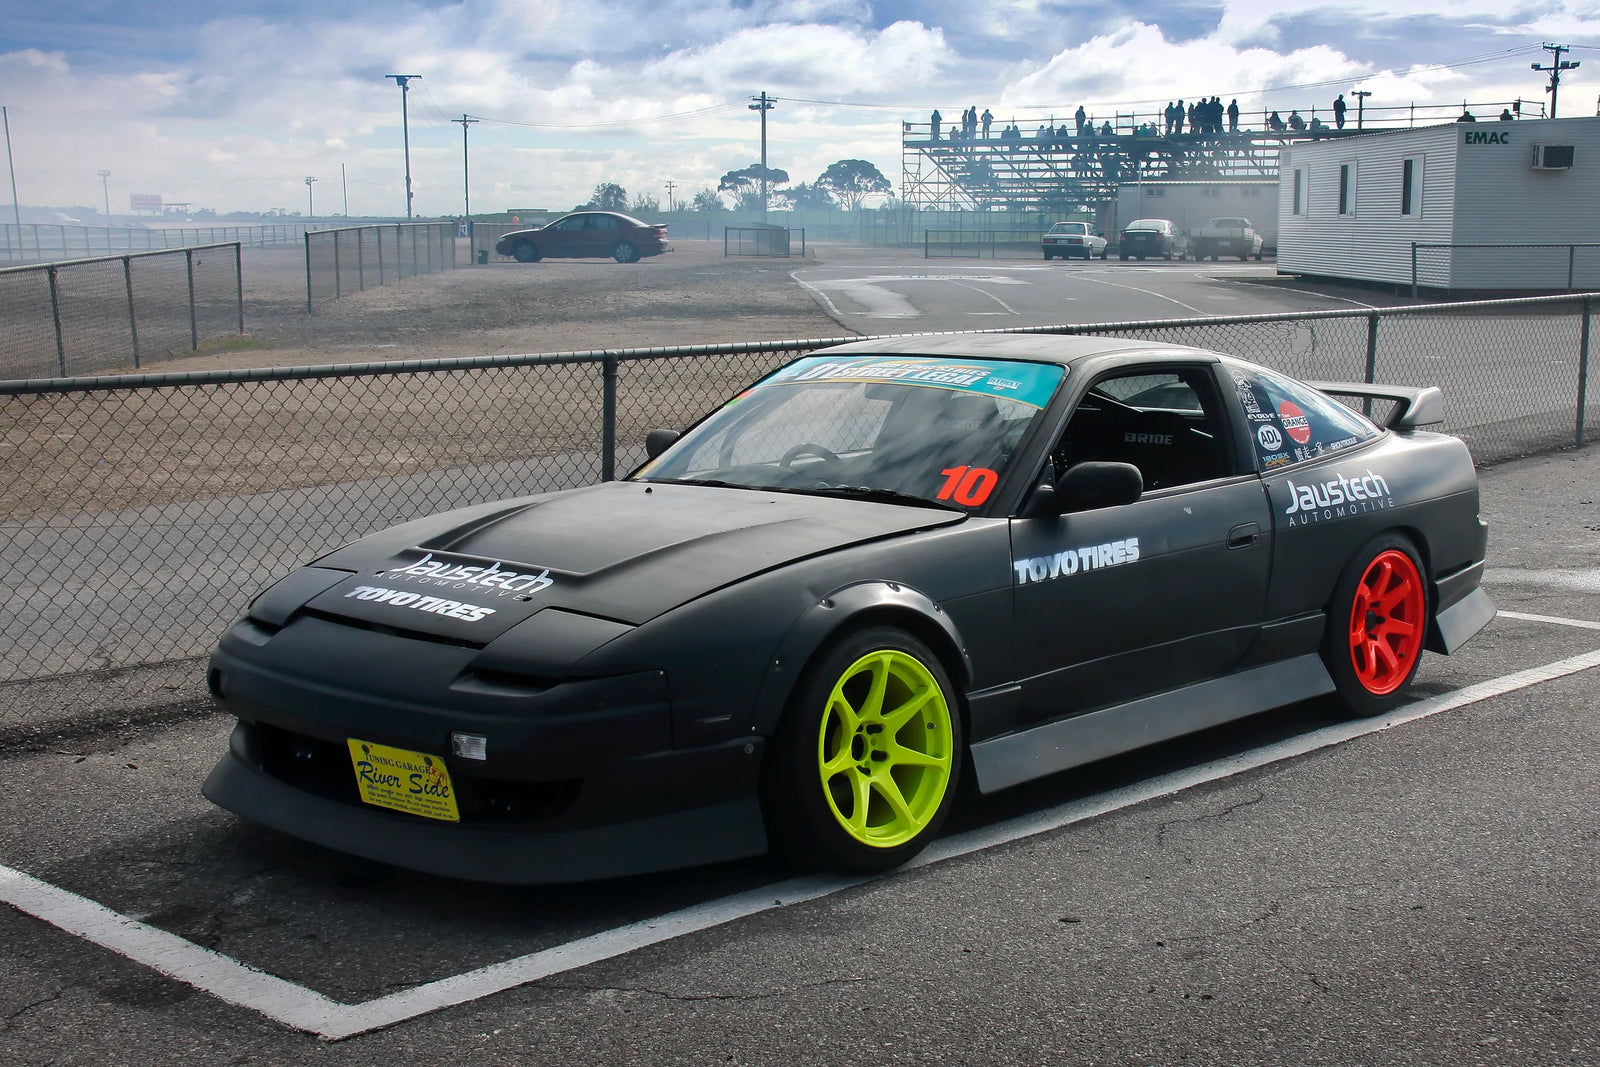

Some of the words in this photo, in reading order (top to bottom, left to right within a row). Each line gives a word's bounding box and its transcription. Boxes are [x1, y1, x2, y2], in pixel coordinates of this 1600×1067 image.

[1465, 132, 1509, 144] EMAC
[834, 367, 921, 379] STREET
[909, 370, 984, 386] LEGAL
[1282, 416, 1308, 428] ORANGE
[1124, 433, 1174, 445] BRIDE
[1261, 430, 1281, 445] ADL
[937, 465, 998, 506] 10
[1286, 469, 1390, 514] Jaustech
[1289, 498, 1395, 527] AUTOMOTIVE
[390, 553, 554, 594] Jaustech
[373, 572, 528, 602] AUTOMOTIVE
[365, 752, 395, 768] TUNING
[395, 761, 430, 774] GARAGE
[357, 761, 401, 788] River
[409, 774, 450, 798] Side
